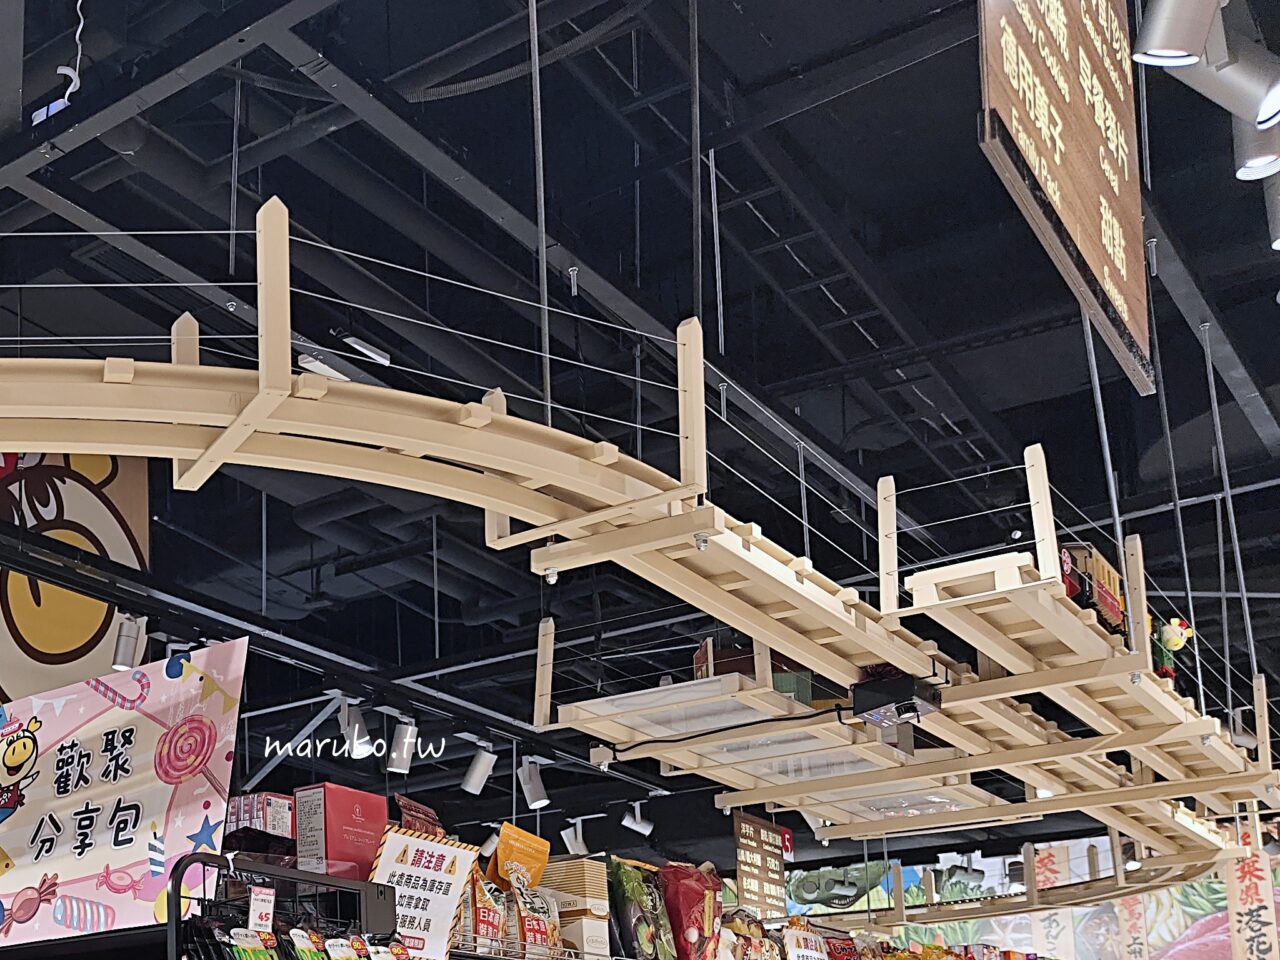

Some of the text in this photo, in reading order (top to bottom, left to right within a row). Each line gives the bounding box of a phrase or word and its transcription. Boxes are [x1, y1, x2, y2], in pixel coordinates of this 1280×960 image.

[410, 847, 447, 872] 請注意
[258, 912, 270, 922] 45
